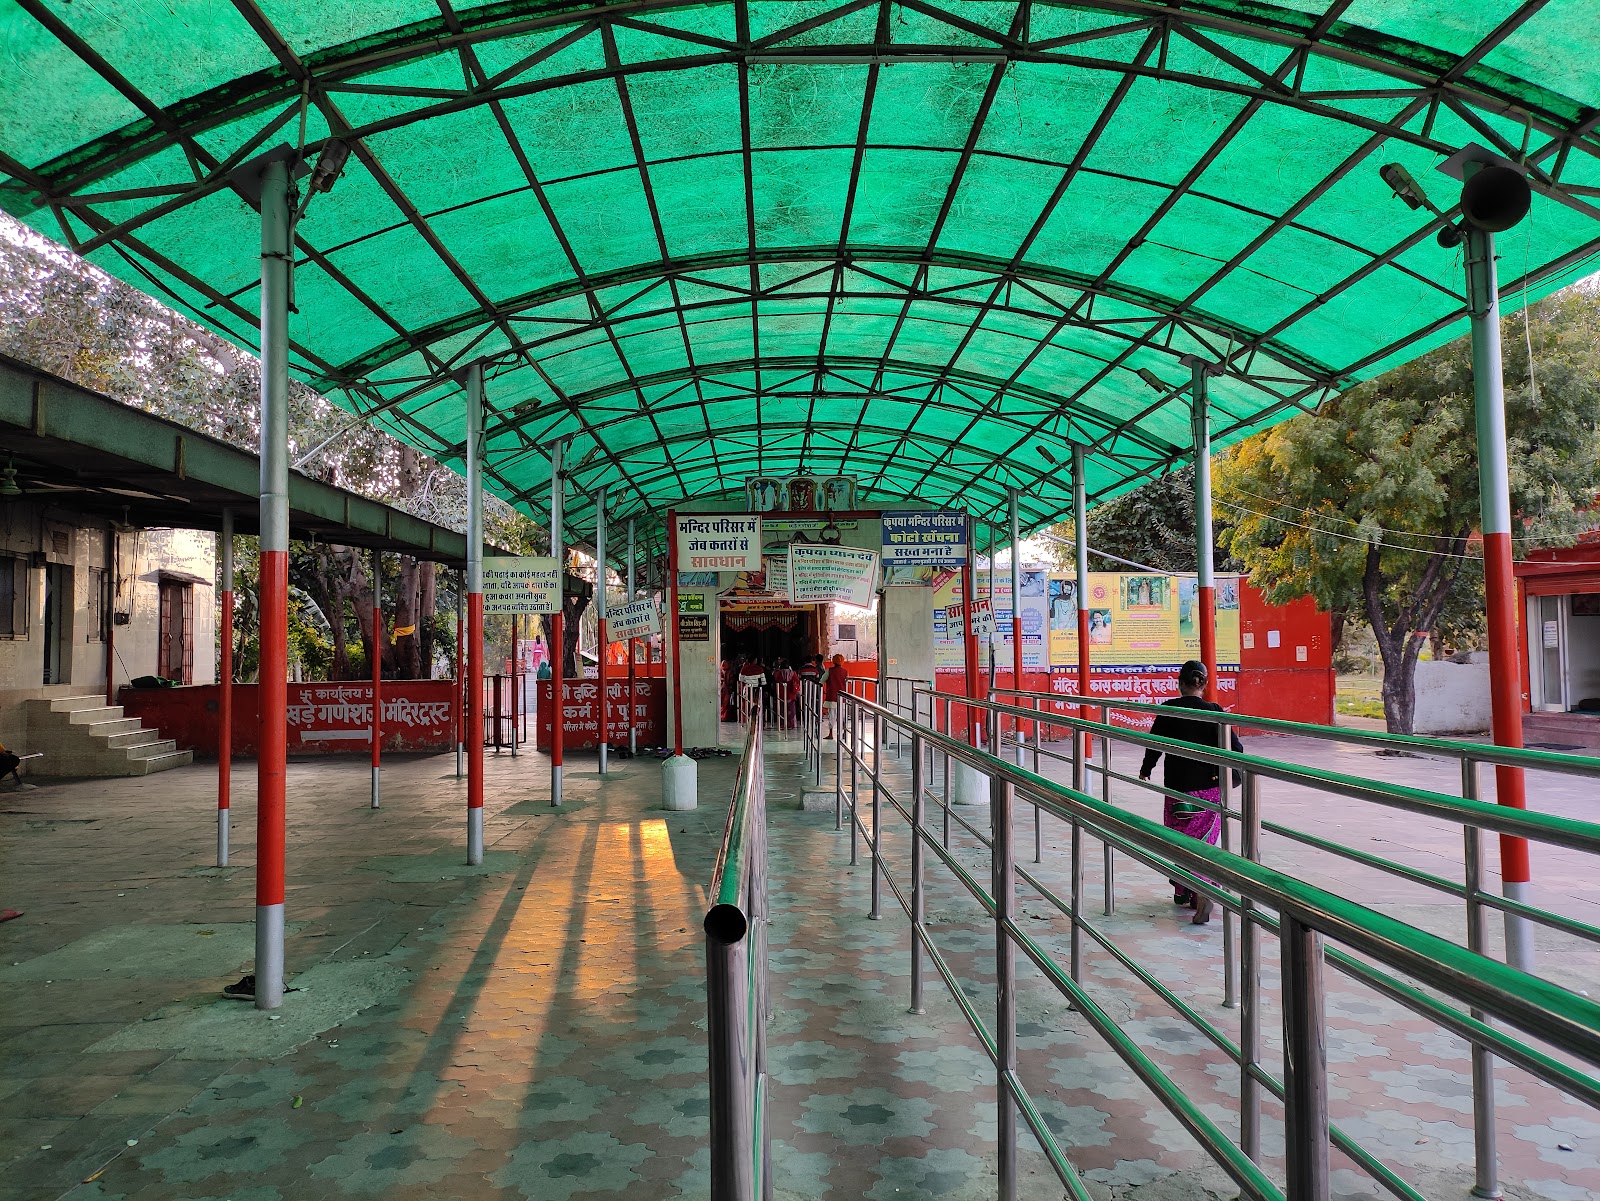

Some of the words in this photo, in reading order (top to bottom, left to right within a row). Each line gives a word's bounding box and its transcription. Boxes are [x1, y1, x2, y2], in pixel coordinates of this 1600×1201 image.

[679, 519, 710, 533] मन्दिर
[712, 519, 745, 533] परिसर
[747, 517, 759, 533] में
[883, 517, 907, 530] कृपया
[908, 515, 931, 527] मन्दिर
[932, 515, 957, 527] परिसर
[958, 513, 966, 527] में
[890, 530, 920, 543] फोटो
[709, 537, 738, 550] कतरों
[740, 537, 749, 550] से
[922, 548, 943, 556] मना
[944, 546, 953, 556] है
[691, 556, 747, 568] सावधान
[519, 570, 530, 579] कोई
[500, 581, 511, 589] यदि
[512, 580, 530, 589] आपके
[485, 593, 497, 602] हुआ
[529, 603, 545, 611] उठाता
[624, 604, 646, 615] परिसर
[948, 600, 990, 618] साधान
[625, 614, 643, 626] कतरों
[643, 613, 651, 622] से
[949, 620, 963, 628] आप
[615, 624, 651, 639] सावधान
[1053, 677, 1079, 695] मंदिर
[1090, 679, 1112, 694] कास
[1112, 676, 1133, 693] कार्य
[1133, 675, 1152, 695] हेतु
[1152, 675, 1179, 694] सहयो
[315, 686, 363, 700] कार्यालय
[287, 699, 318, 729] खड़े
[386, 698, 420, 727] मंदिर
[420, 702, 451, 726] ट्रस्ट
[562, 702, 593, 719] कर्म
